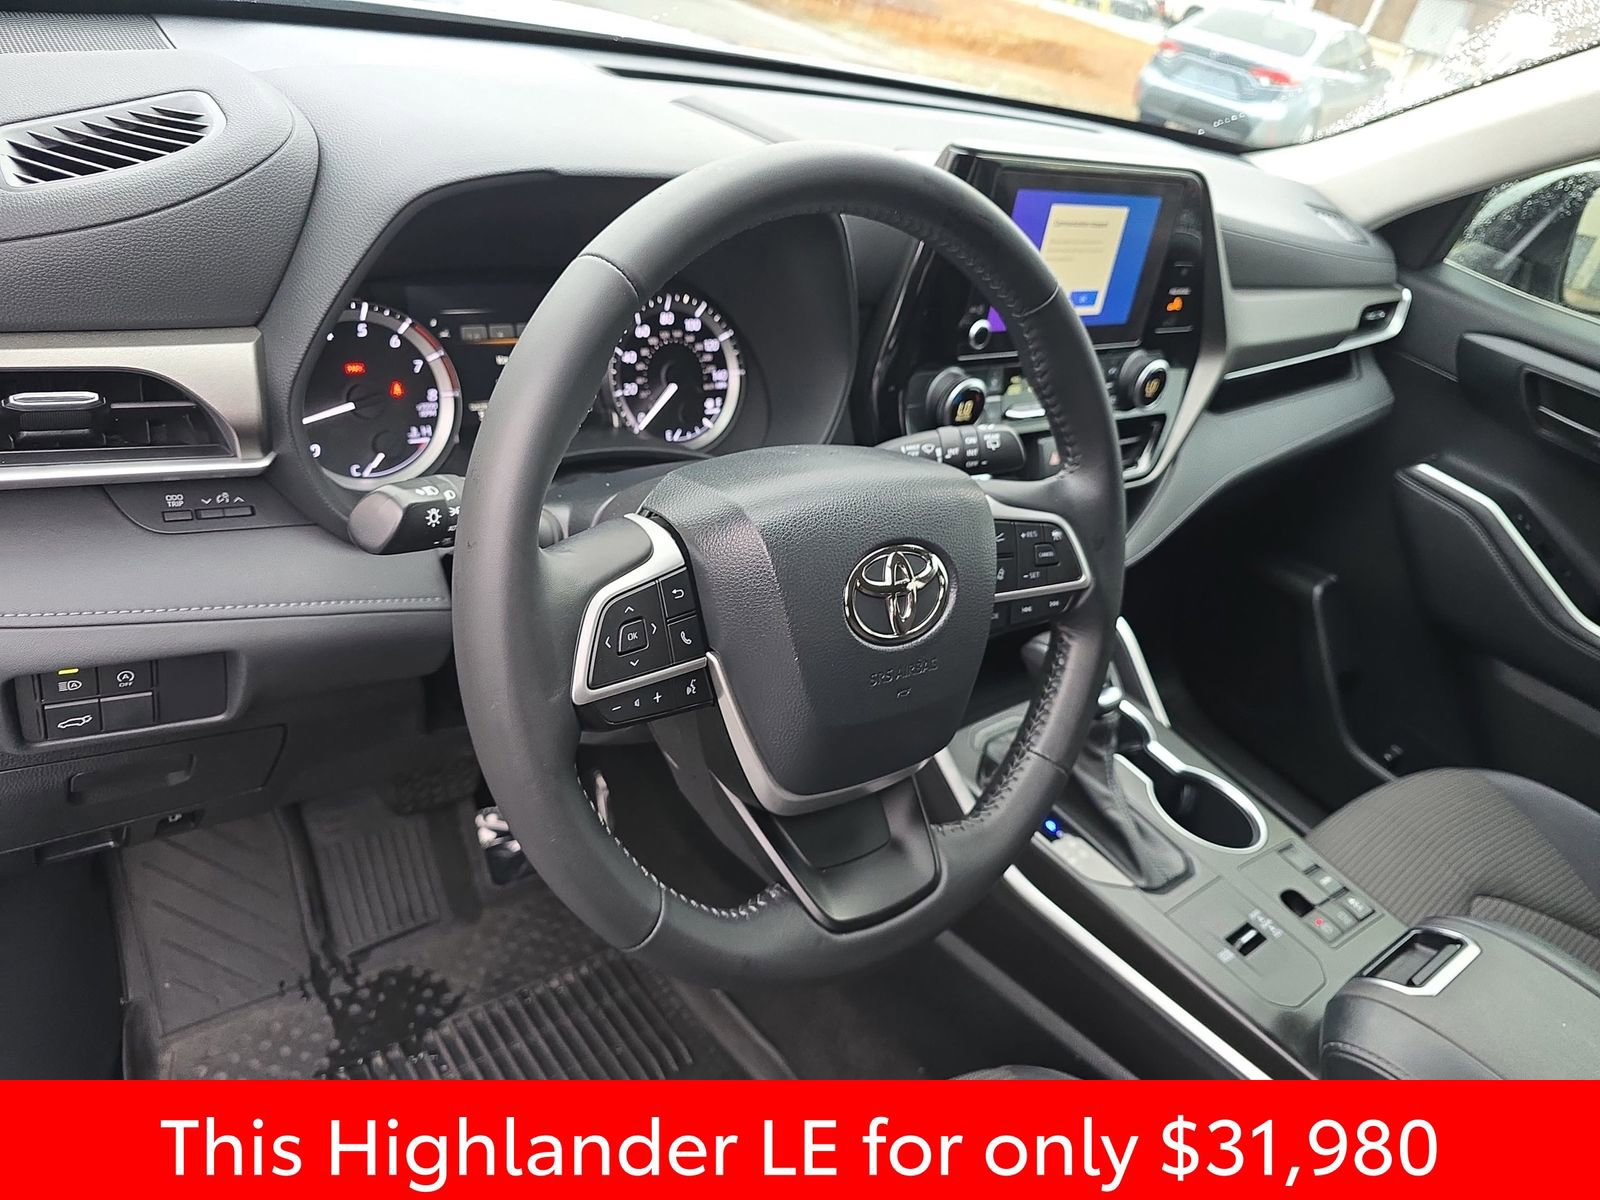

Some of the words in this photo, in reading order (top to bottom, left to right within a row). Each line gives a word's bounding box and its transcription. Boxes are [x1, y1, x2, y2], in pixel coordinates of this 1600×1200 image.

[357, 323, 368, 338] 5
[389, 335, 401, 349] 6
[413, 359, 423, 374] 7
[427, 388, 439, 402] 8
[350, 464, 362, 477] C
[166, 500, 184, 508] TRIP
[627, 631, 639, 641] OK
